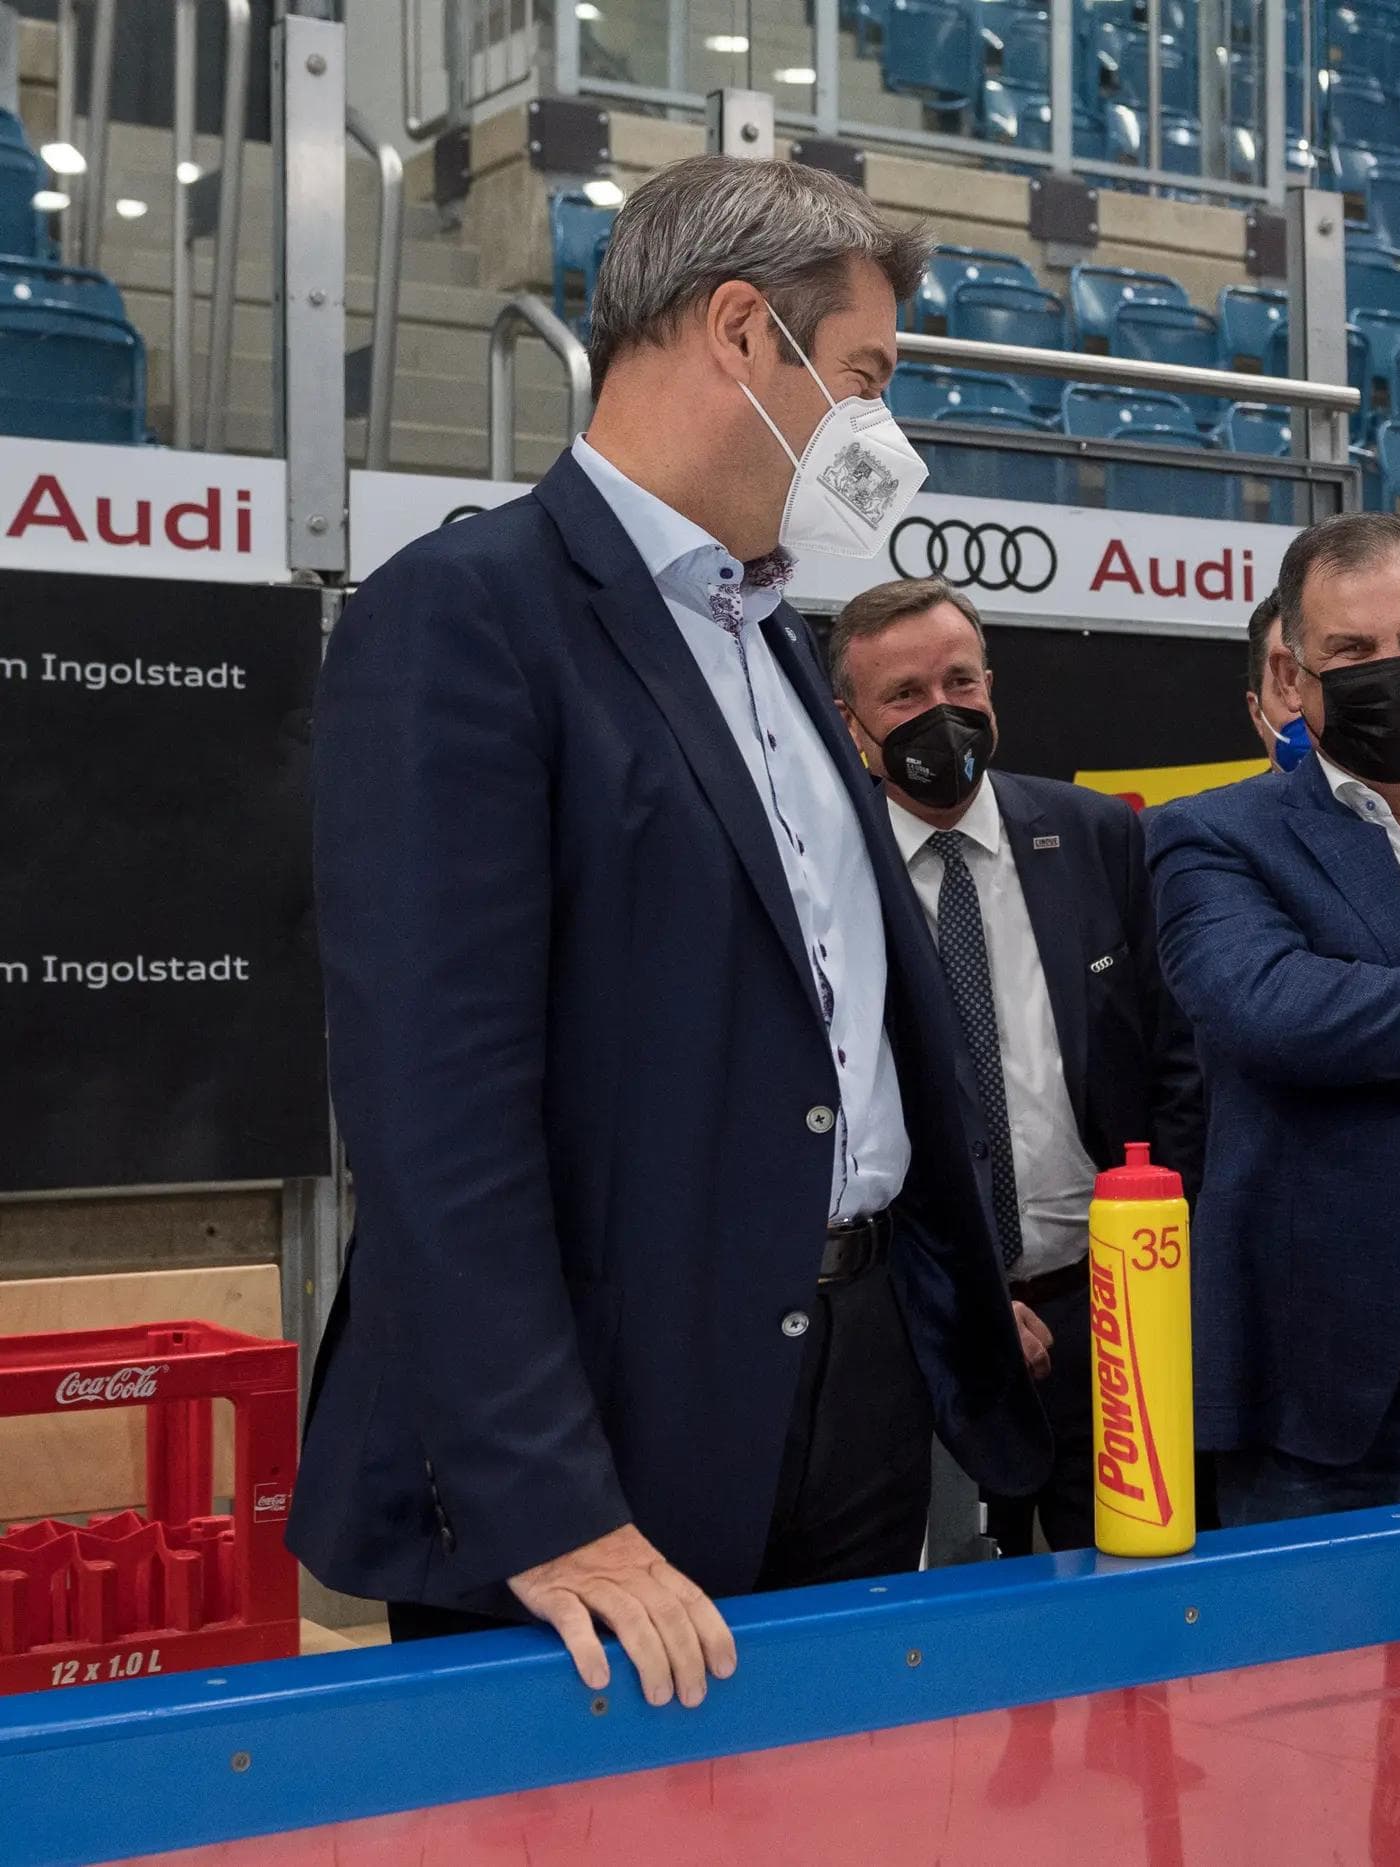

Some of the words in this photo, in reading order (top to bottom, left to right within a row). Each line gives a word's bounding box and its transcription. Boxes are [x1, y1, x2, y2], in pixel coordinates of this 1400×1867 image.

[6, 474, 252, 553] Audi
[1089, 539, 1254, 602] Audi
[41, 653, 247, 690] Ingolstadt
[42, 954, 250, 989] Ingolstadt
[1131, 1226, 1181, 1271] 35
[55, 1365, 162, 1405] Coca-Cola
[1090, 1252, 1146, 1502] PowerBar
[51, 1660, 77, 1686] 12
[84, 1662, 98, 1681] x
[109, 1651, 143, 1679] 1.0
[148, 1649, 163, 1672] L
